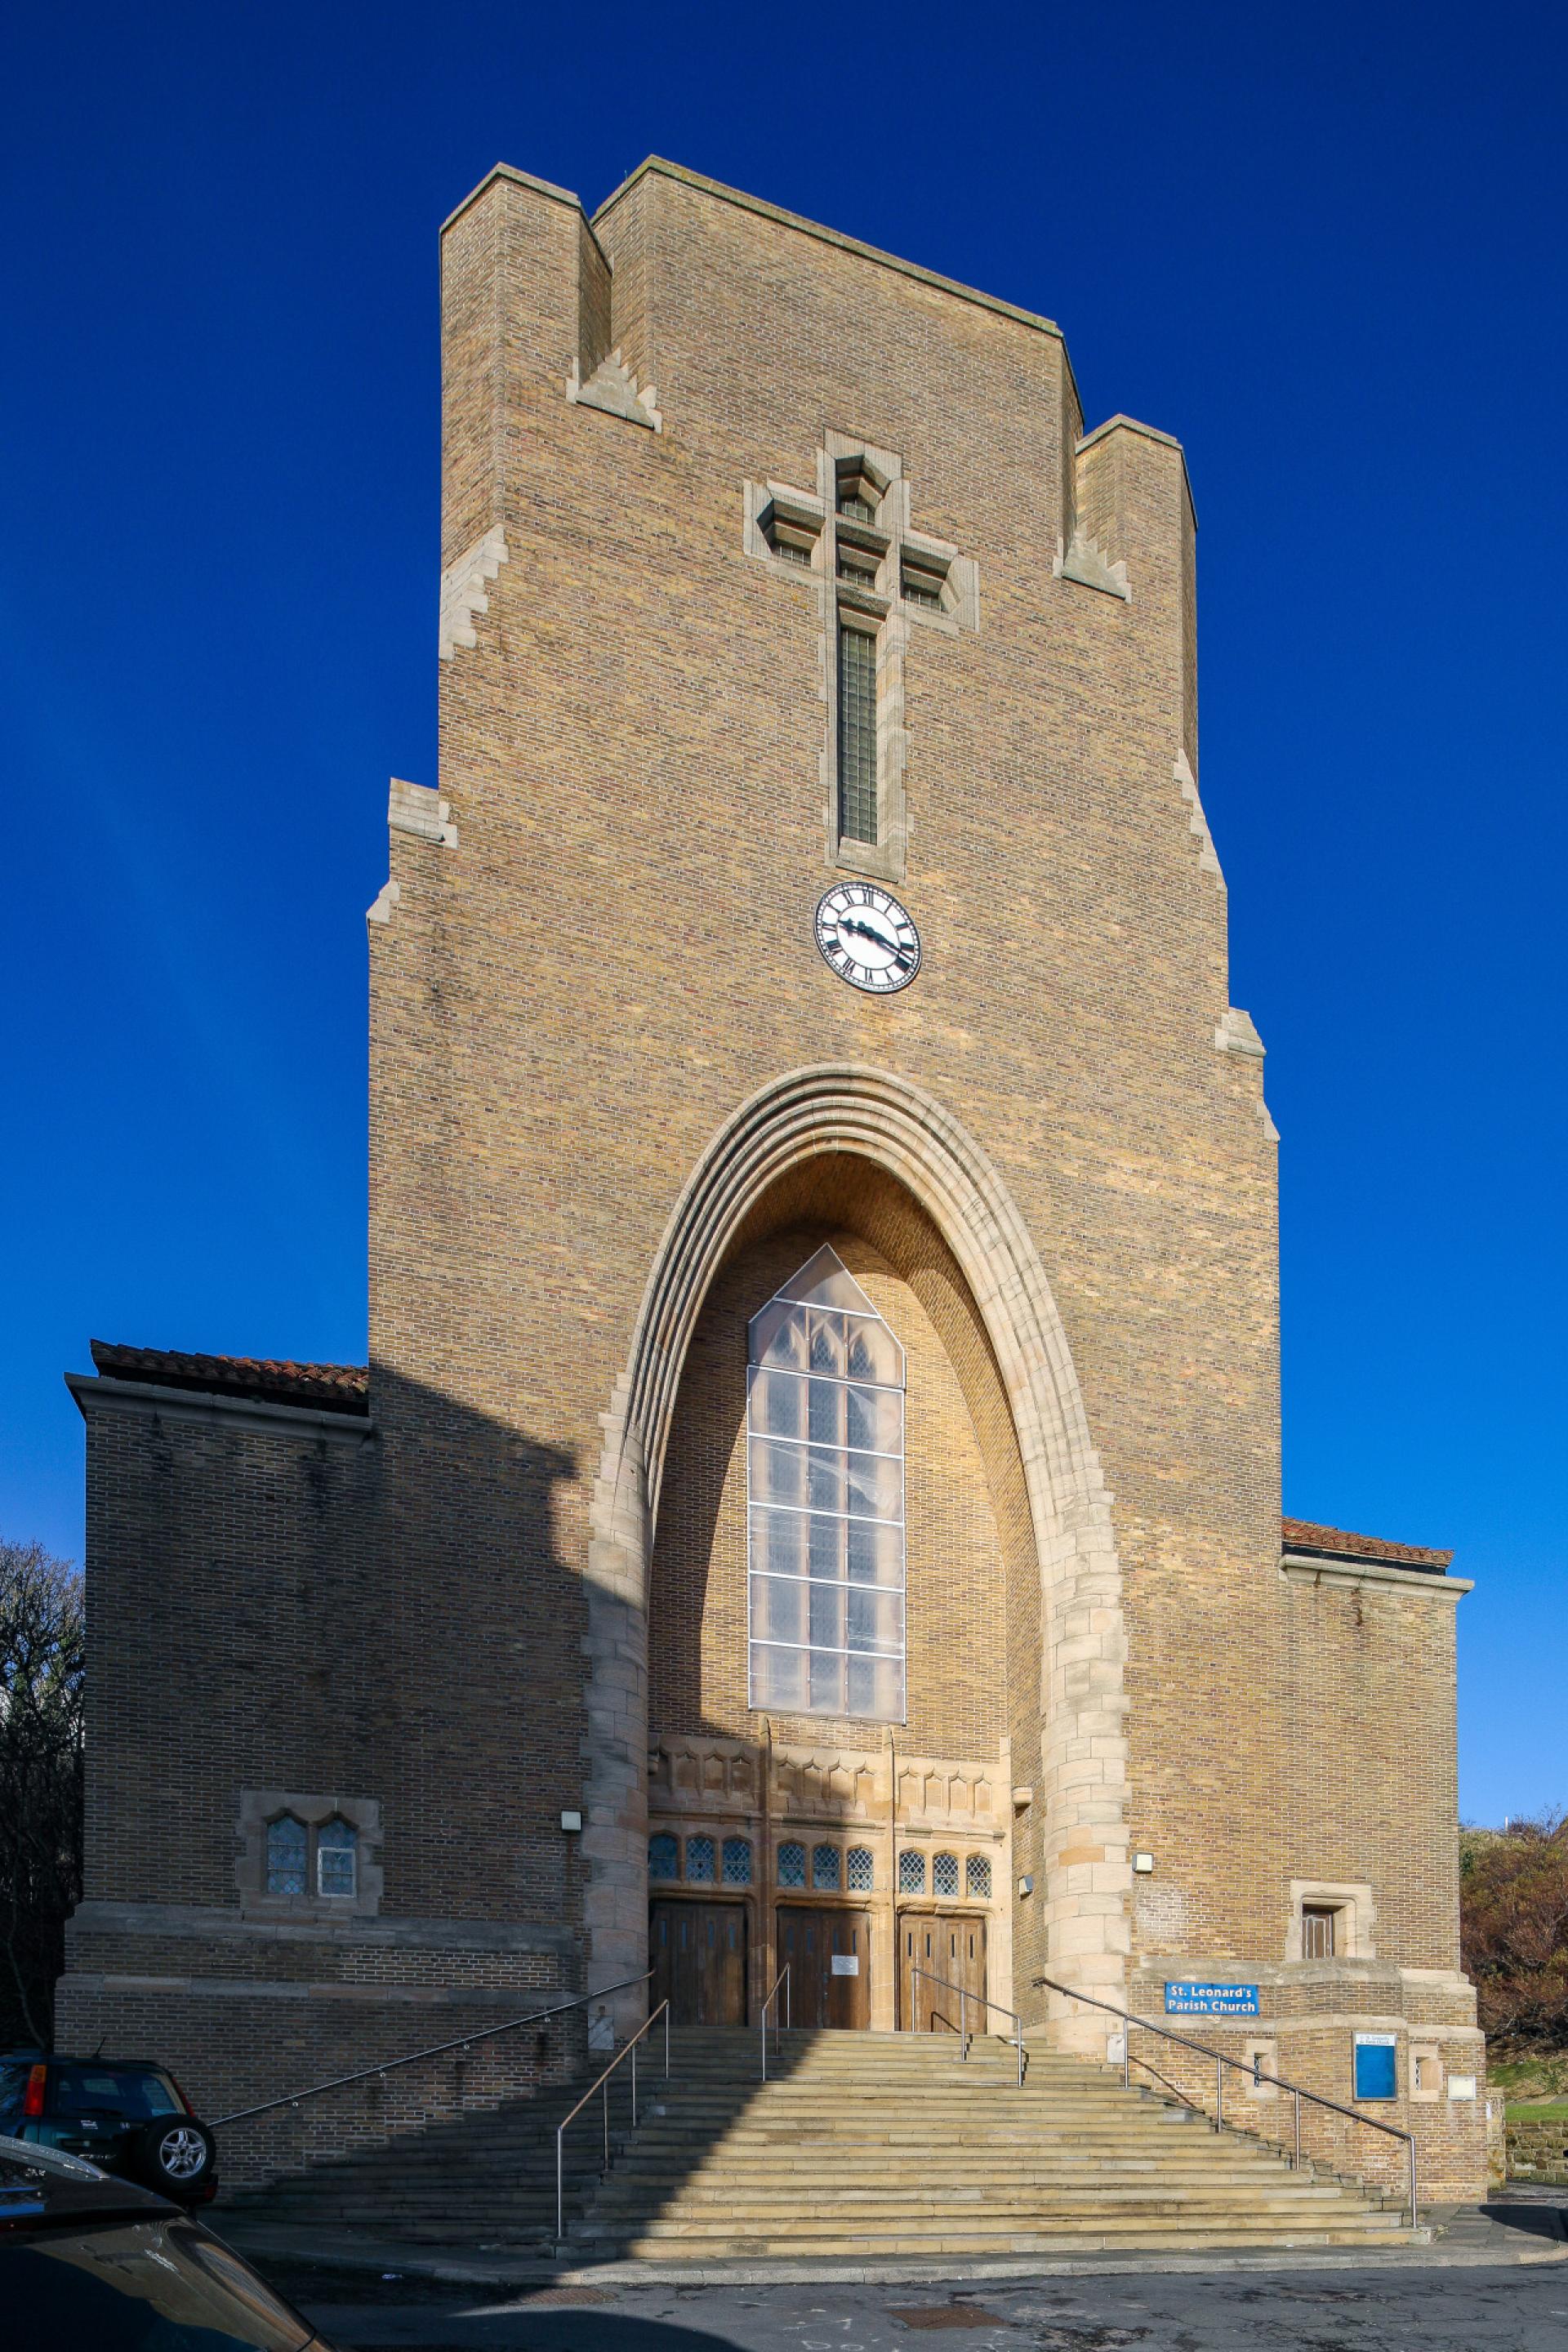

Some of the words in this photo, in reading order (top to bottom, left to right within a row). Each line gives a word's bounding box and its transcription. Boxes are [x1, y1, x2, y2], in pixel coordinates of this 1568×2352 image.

[1170, 1985, 1187, 1996] St.
[1191, 1986, 1252, 1998] Leonard's
[1168, 1999, 1208, 2011] Parish
[1212, 2001, 1255, 2012] Church
